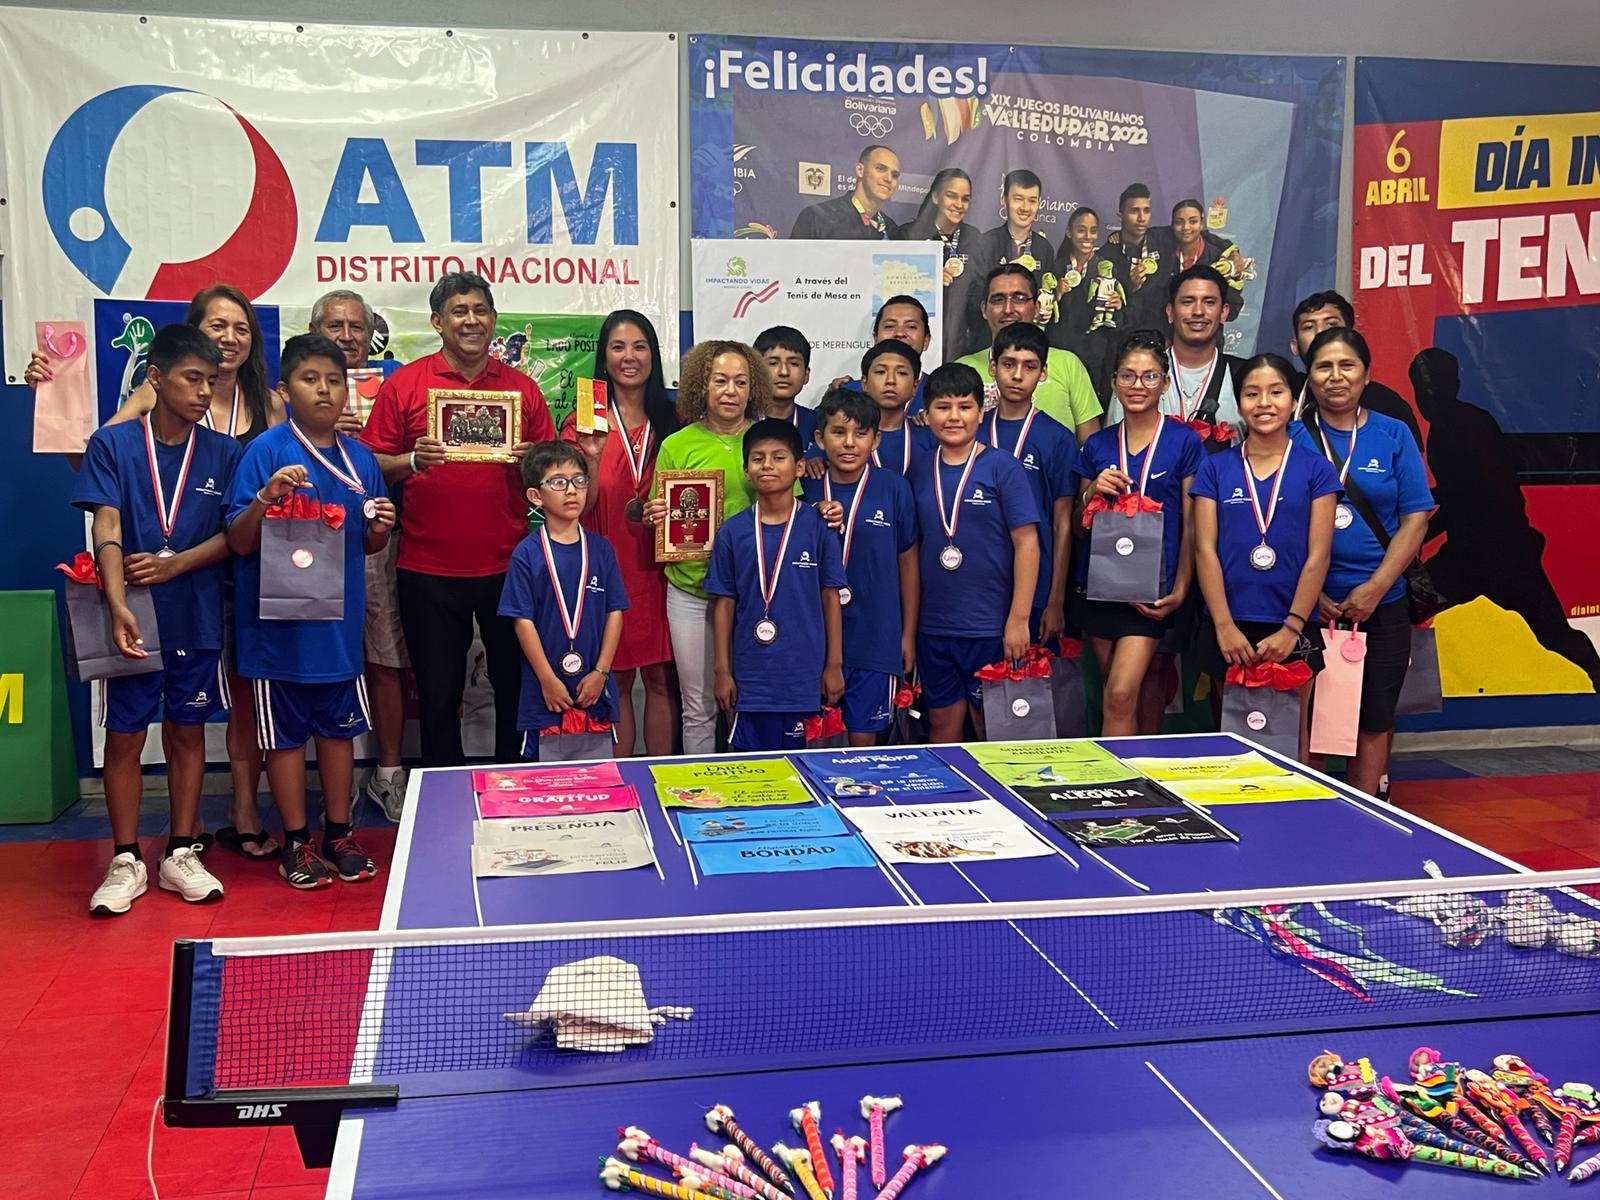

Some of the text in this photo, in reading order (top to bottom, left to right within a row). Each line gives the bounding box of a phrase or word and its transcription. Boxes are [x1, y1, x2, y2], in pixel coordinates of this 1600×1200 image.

[704, 50, 988, 98] ¡Felicidades!
[844, 99, 897, 116] Bolivariana
[990, 93, 1145, 126] XIX JUEGOS BOLIVARIANOS
[982, 104, 1149, 146] VALLEDUPAR 2022
[1016, 131, 1116, 153] COLOMBIA
[1386, 129, 1411, 174] 6
[1474, 124, 1551, 193] DÍA
[314, 137, 640, 246] ATM
[1365, 177, 1430, 206] ABRIL
[1359, 243, 1433, 289] DEL
[1451, 210, 1600, 304] TEN
[316, 255, 640, 286] DISTRITO NACIONAL
[795, 276, 848, 285] A través del
[786, 291, 807, 300] Tenis
[810, 291, 822, 300] de
[824, 291, 845, 300] Mesa
[822, 340, 872, 350] MERENGUE
[559, 368, 574, 389] El
[693, 768, 766, 778] POSITIVO
[517, 793, 610, 804] GRATITUD
[511, 820, 616, 832] PRESENCIA
[740, 845, 837, 859] BONDAD
[236, 1103, 288, 1119] DHS
